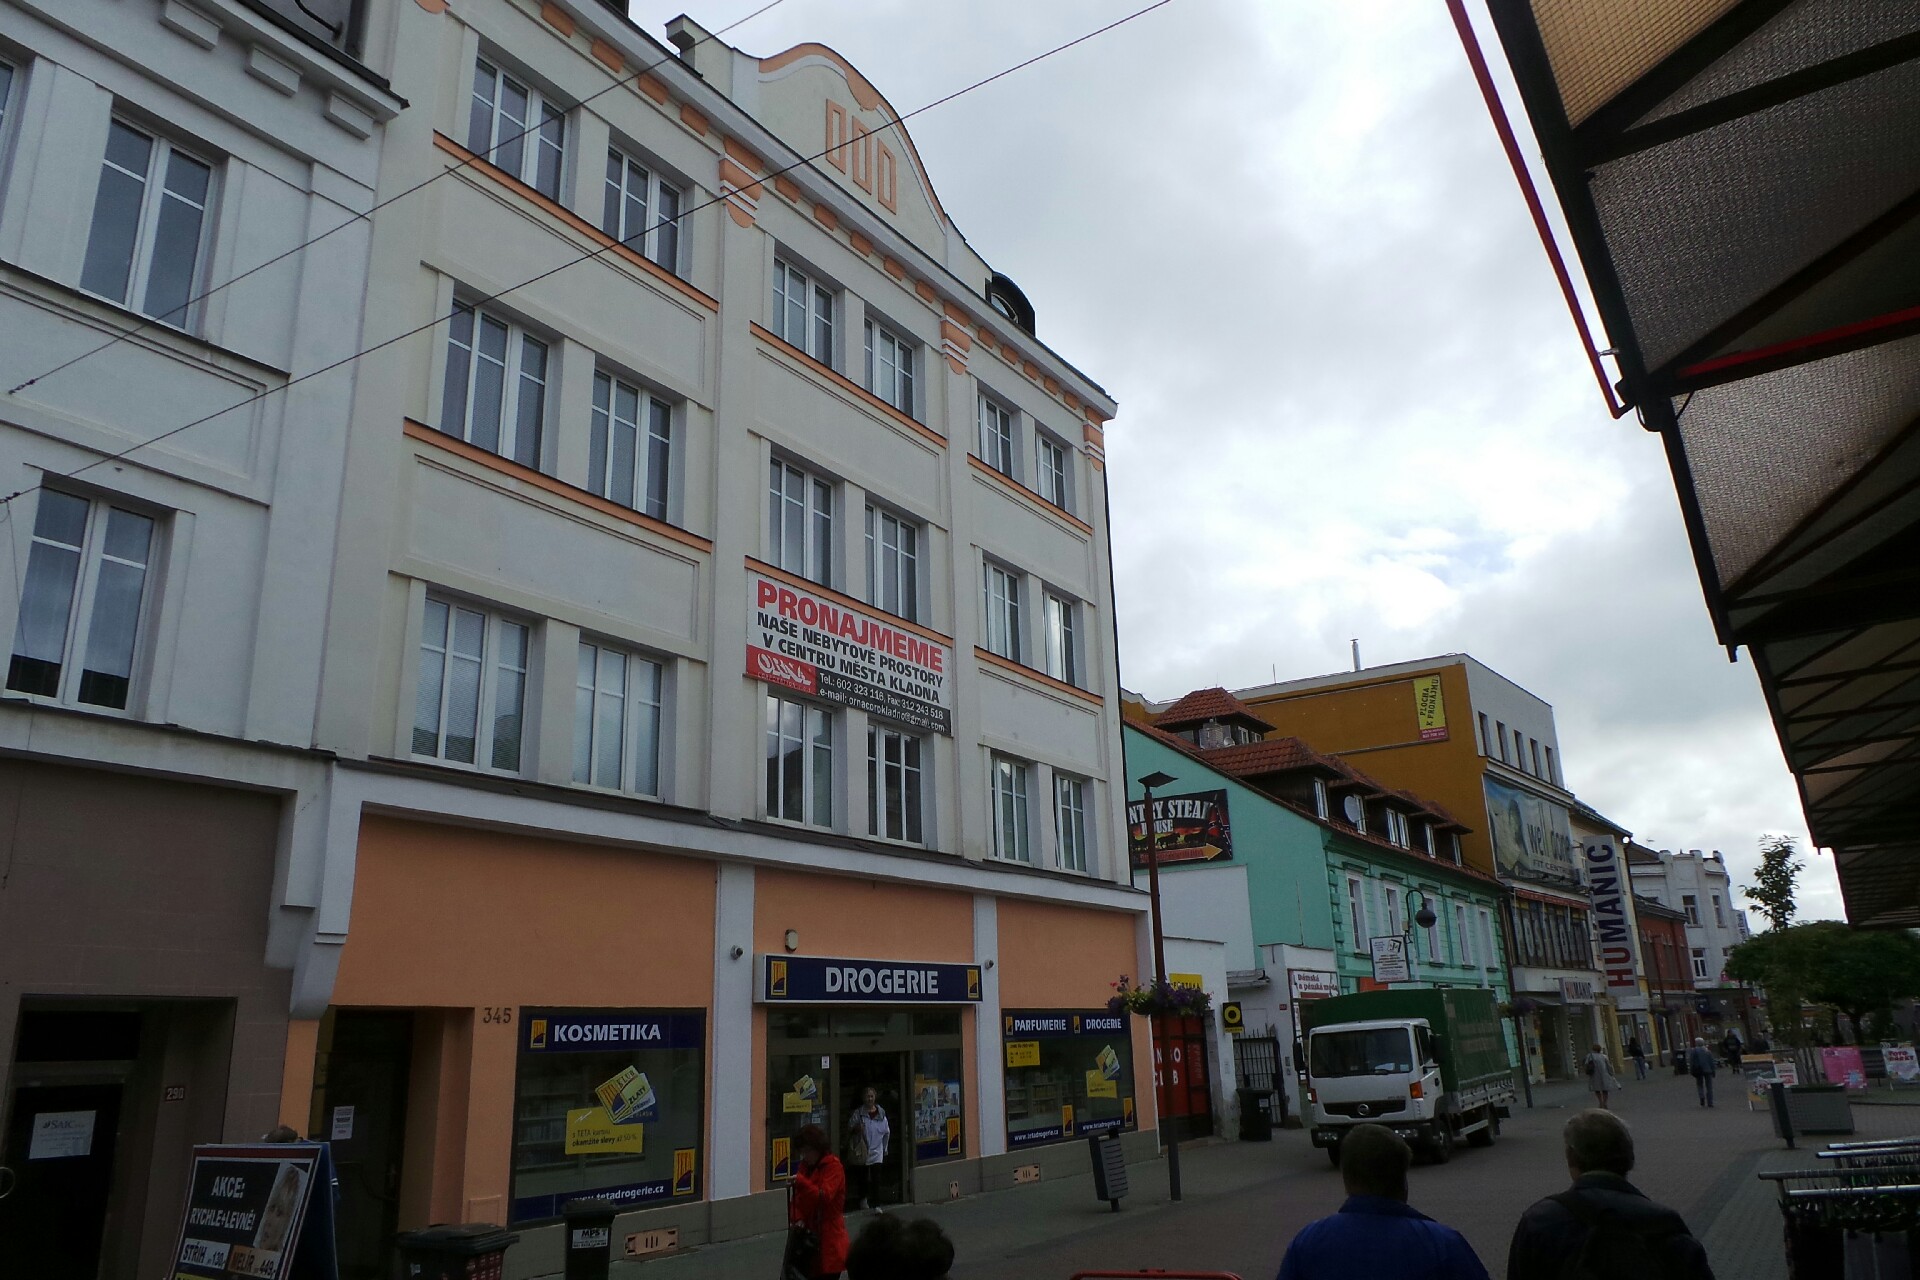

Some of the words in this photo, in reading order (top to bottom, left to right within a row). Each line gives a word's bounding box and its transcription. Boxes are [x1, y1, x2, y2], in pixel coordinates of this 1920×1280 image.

[757, 580, 943, 673] PRONAJMEME
[757, 611, 798, 638] NAŠE
[803, 627, 875, 665] NEBYTOVÉ
[880, 654, 943, 688] PROSTORY
[763, 632, 774, 648] V
[778, 638, 836, 669] CENTRU
[840, 659, 886, 686] MĚSTA
[890, 675, 939, 704] KLADNA
[820, 688, 847, 703] e-mail:
[836, 678, 852, 692] 602
[853, 683, 869, 697] 323
[901, 699, 914, 710] 312
[915, 704, 929, 716] 243
[1140, 819, 1174, 836] HUSE
[1586, 844, 1634, 987] HUMANIC
[825, 966, 939, 994] DROGERIE
[1564, 981, 1593, 1000] HUMANIC
[483, 1007, 512, 1024] 345
[1014, 1019, 1067, 1031] PARFUMERIE
[1085, 1018, 1122, 1030] DROGERIE
[554, 1024, 661, 1042] KOSMETIKA
[211, 1176, 246, 1199] AKCE:
